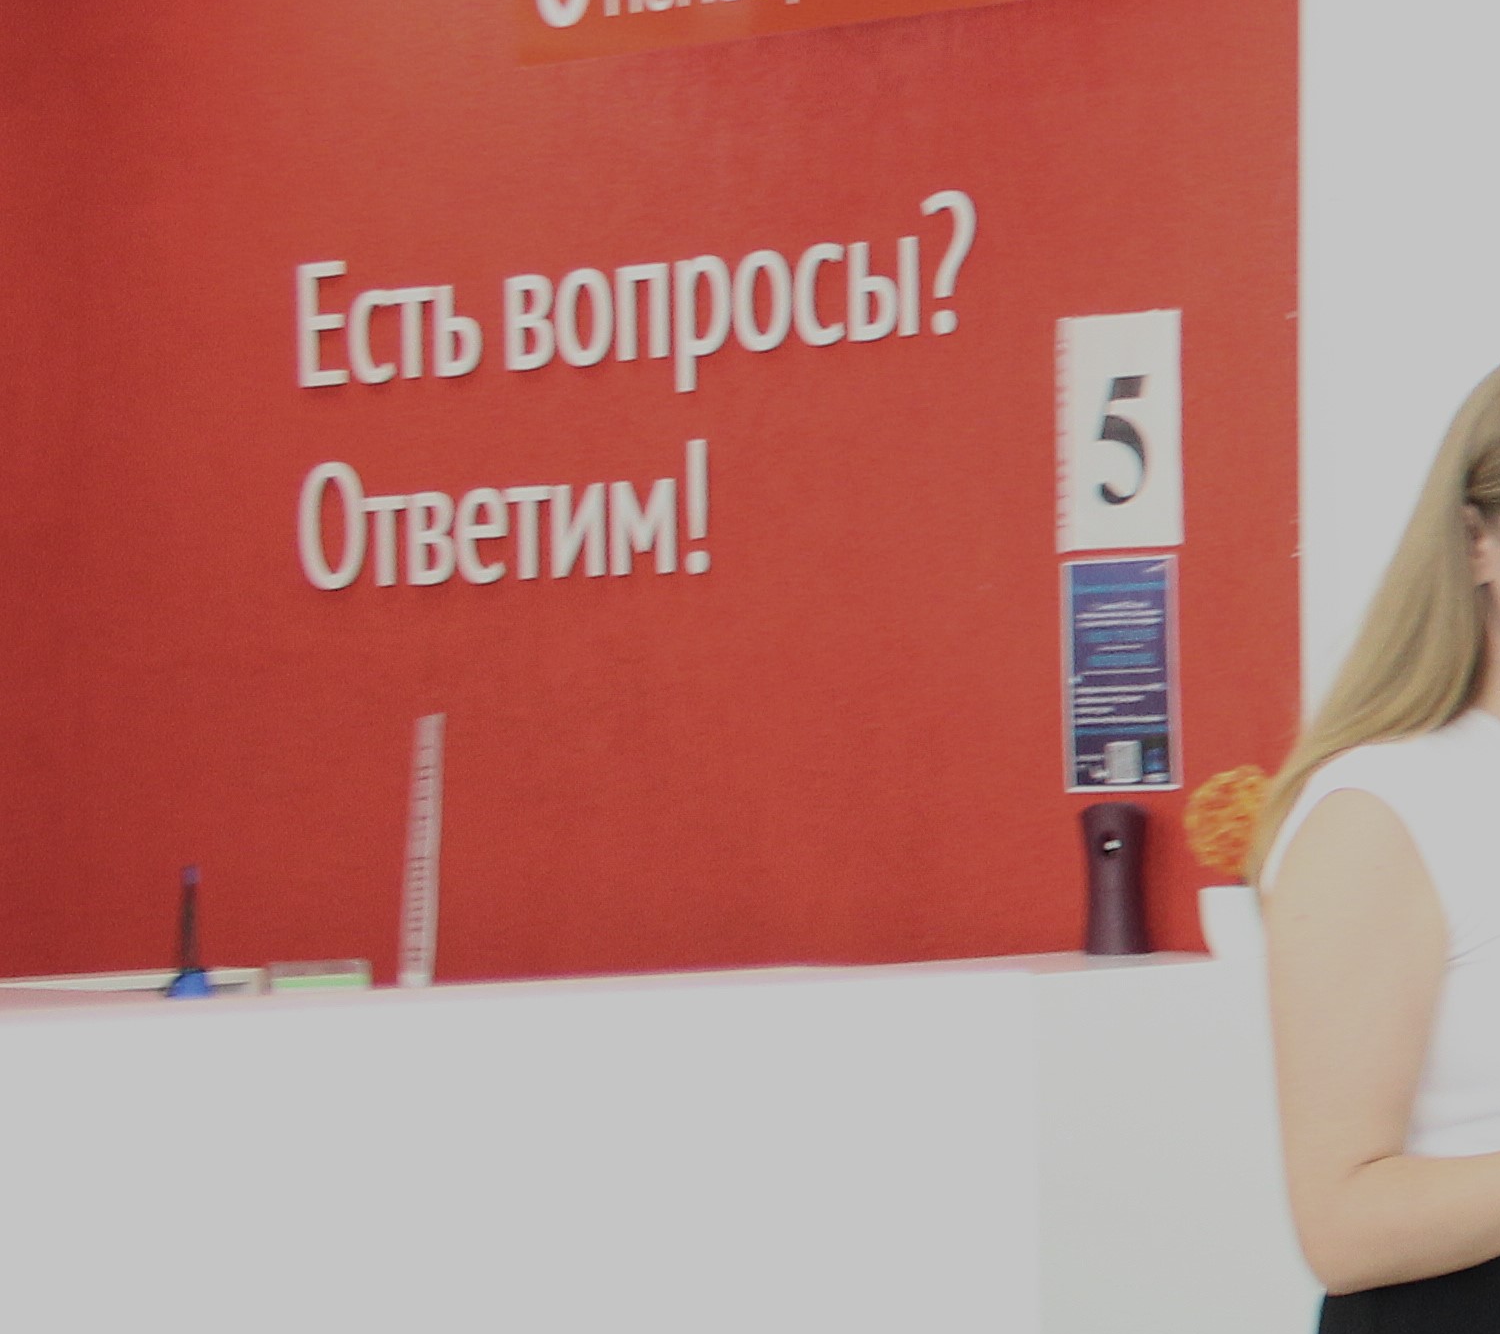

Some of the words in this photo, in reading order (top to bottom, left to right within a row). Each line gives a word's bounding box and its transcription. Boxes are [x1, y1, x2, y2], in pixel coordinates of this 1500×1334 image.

[297, 259, 484, 389] Есть
[503, 189, 978, 393] вопросы?
[299, 439, 711, 592] Ответим!
[1096, 374, 1150, 507] 5
